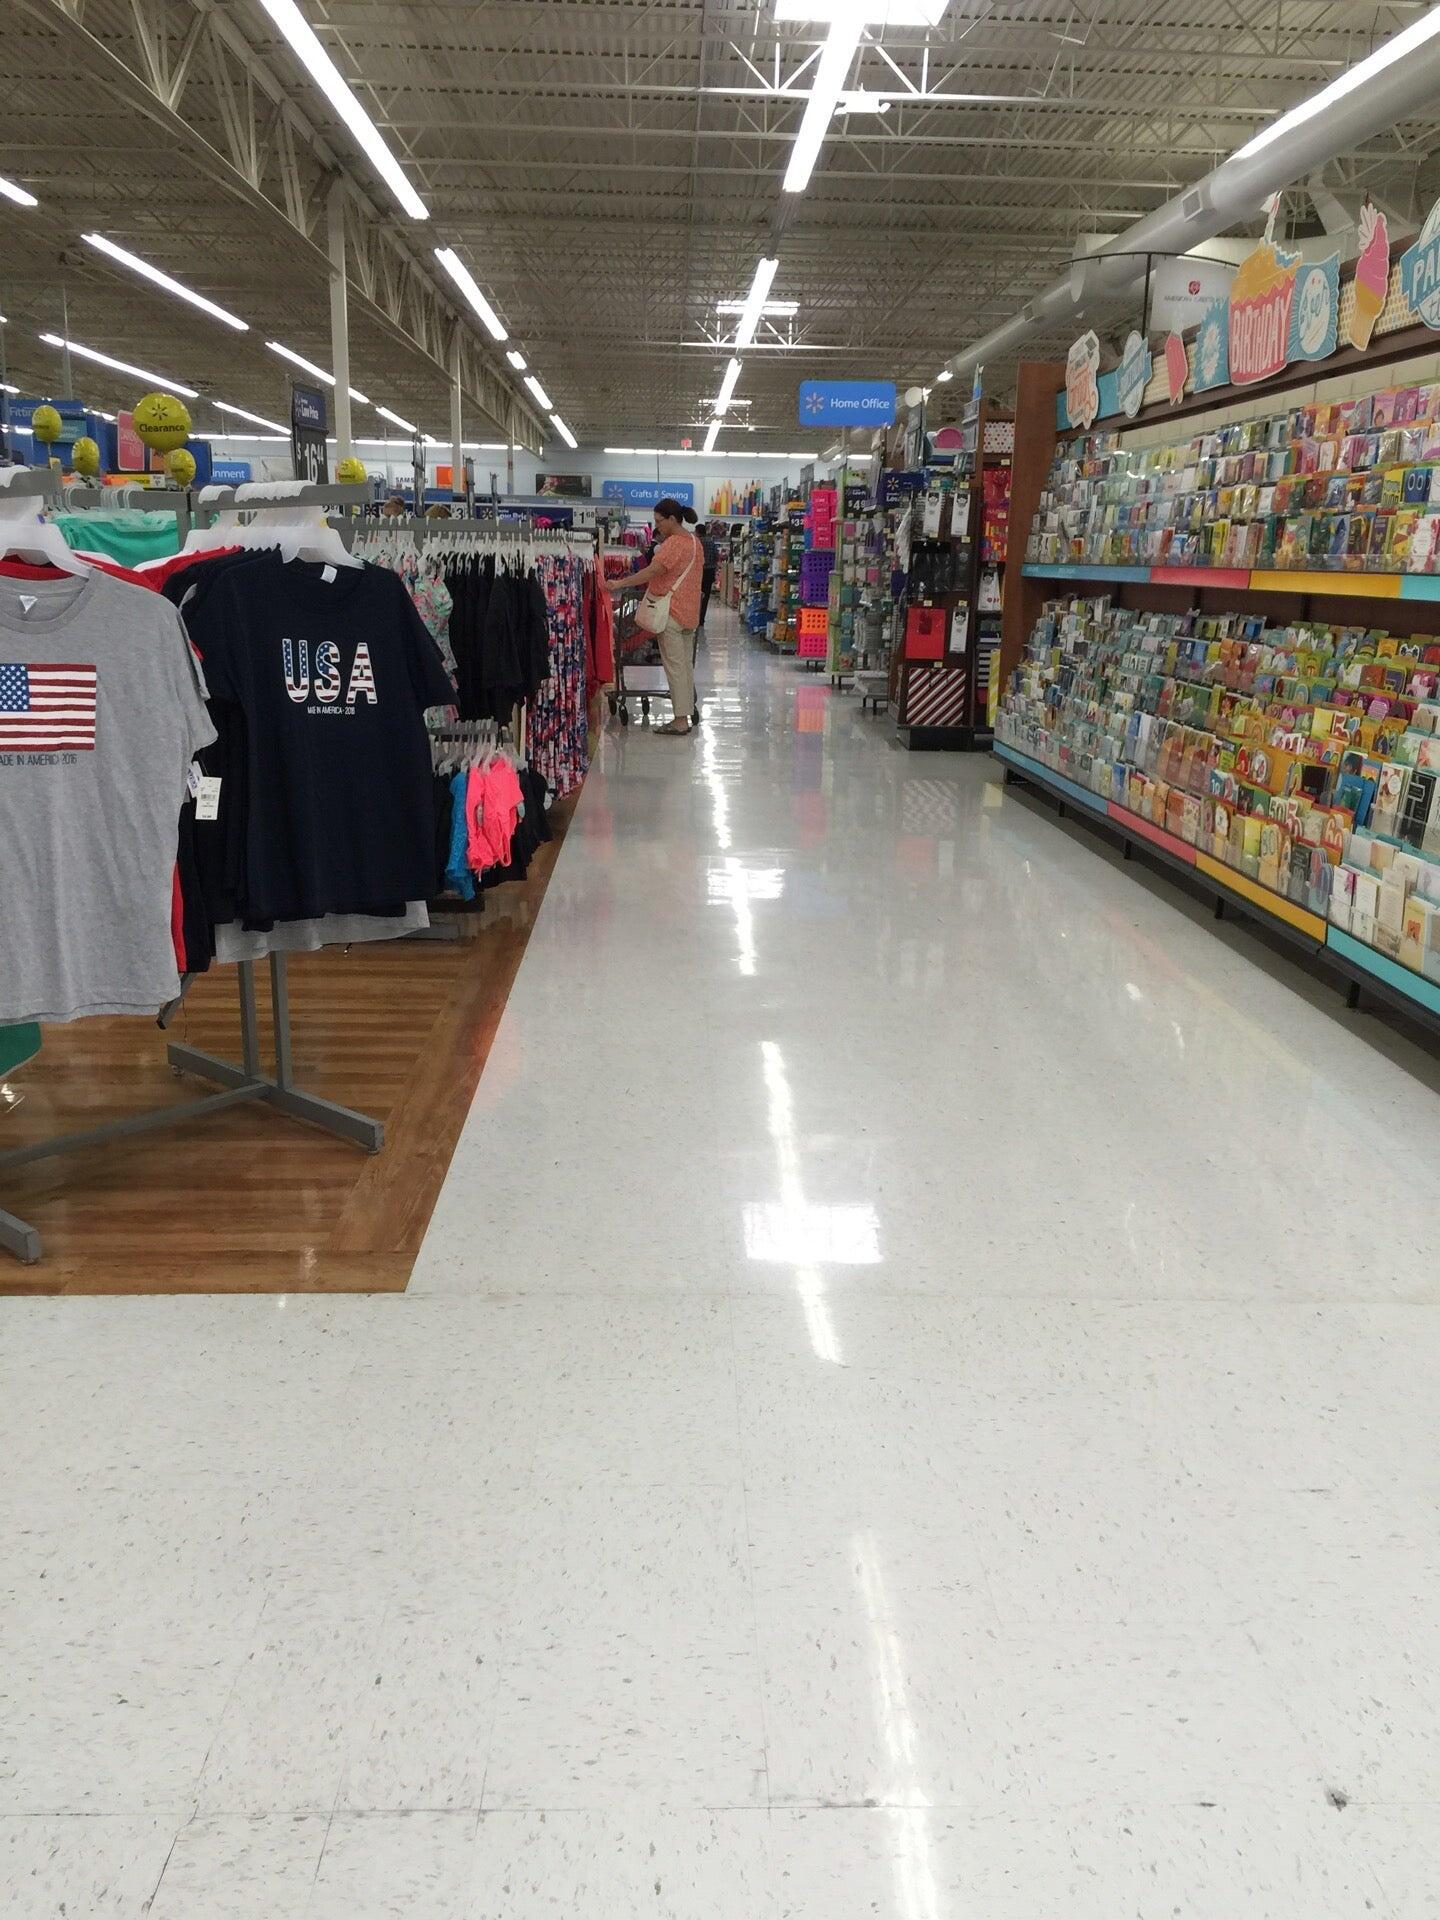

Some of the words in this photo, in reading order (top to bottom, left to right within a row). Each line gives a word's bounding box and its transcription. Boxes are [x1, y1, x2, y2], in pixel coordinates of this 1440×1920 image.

[1412, 248, 1440, 302] PA
[1231, 288, 1292, 374] BIRTHDAY
[830, 398, 859, 409] Home
[861, 398, 890, 409] Office
[139, 424, 186, 433] Clearance
[630, 489, 652, 498] Crafts
[653, 490, 659, 498] &
[661, 490, 689, 501] Sewing
[282, 638, 378, 704] USA
[16, 754, 25, 765] IN
